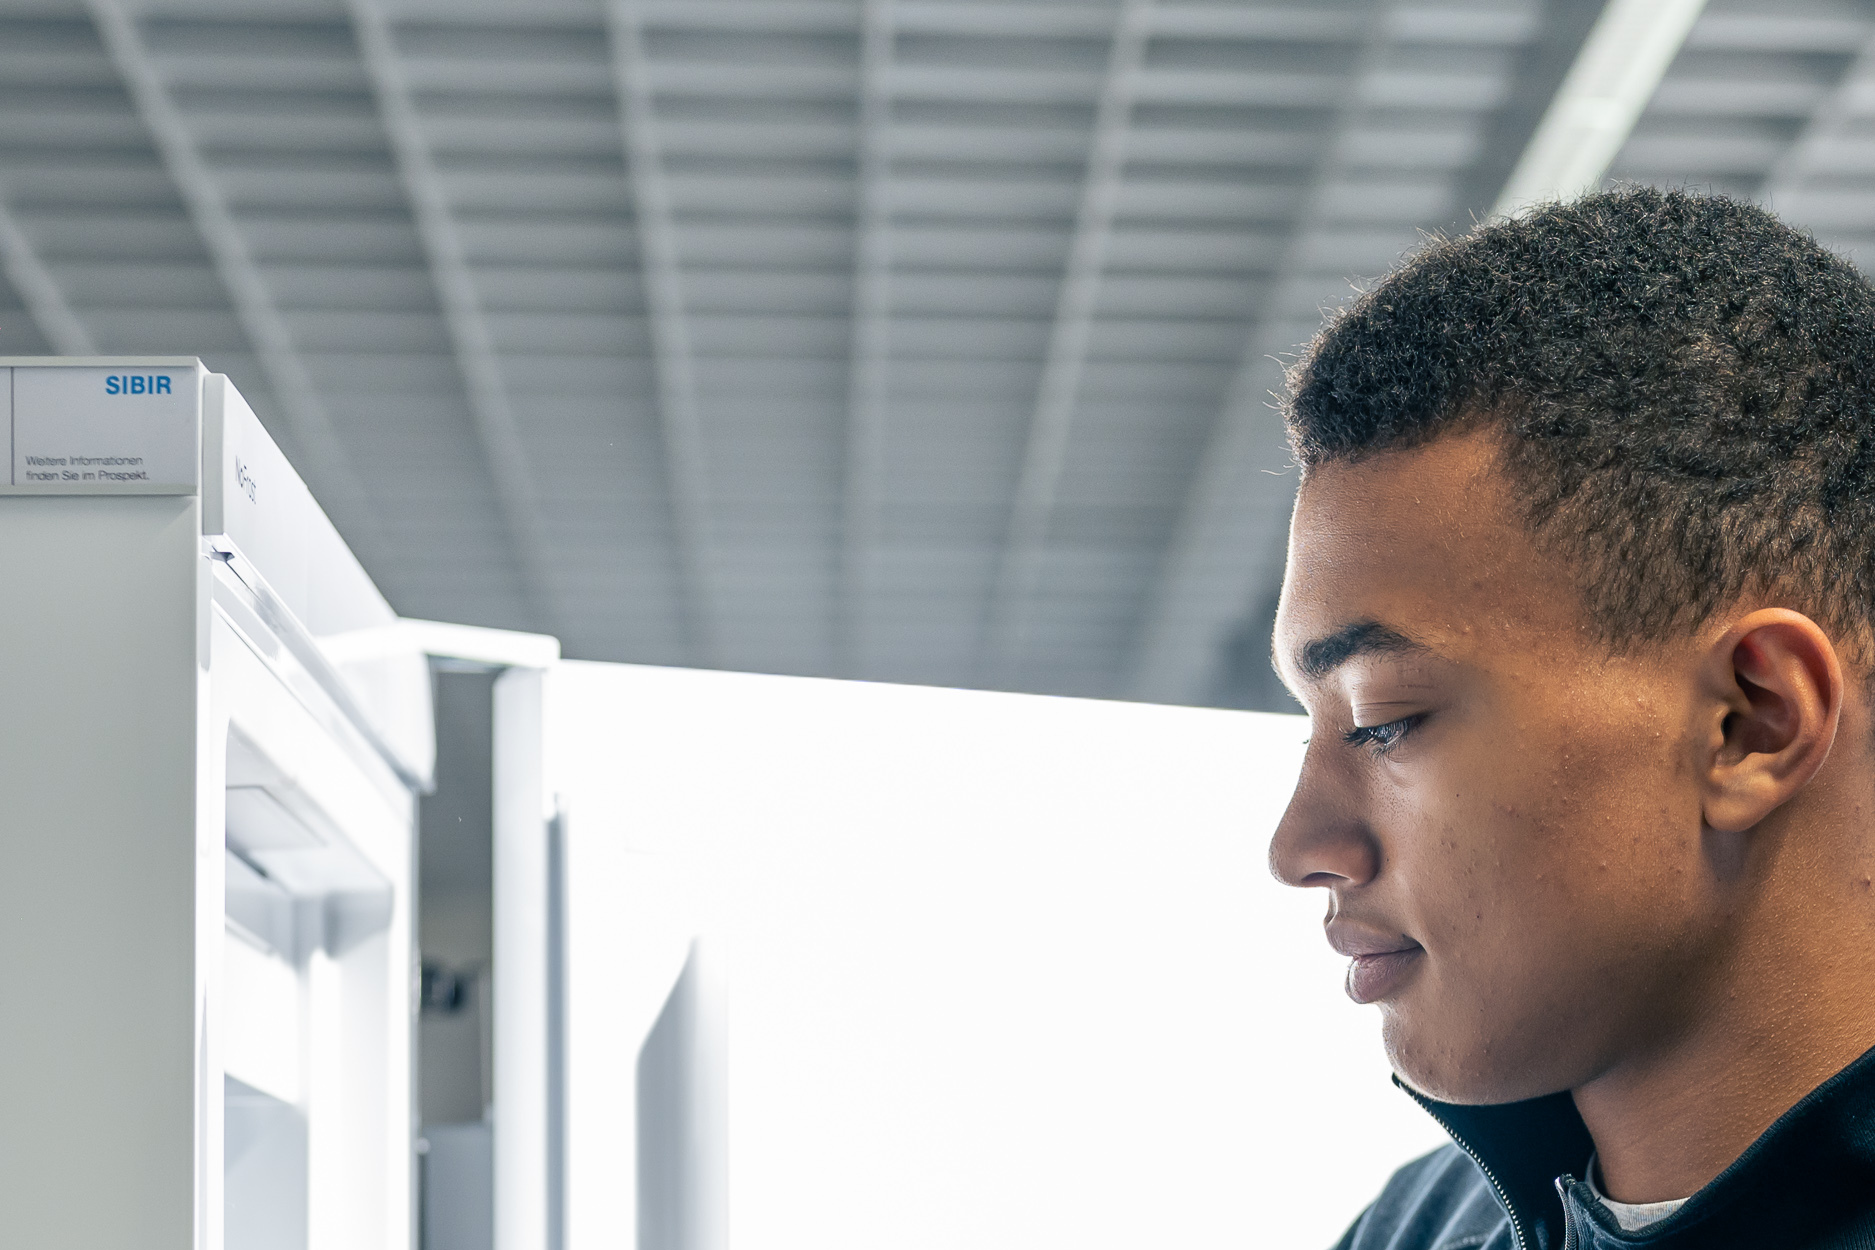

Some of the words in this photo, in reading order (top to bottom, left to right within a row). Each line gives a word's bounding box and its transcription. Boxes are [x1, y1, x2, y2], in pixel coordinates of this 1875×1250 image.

[105, 375, 172, 395] SIBIR
[25, 456, 67, 466] Weitere
[69, 456, 143, 466] Informationen
[26, 470, 60, 481] finden
[61, 470, 79, 481] Sie
[82, 471, 95, 480] im
[98, 470, 149, 482] Prospekt.
